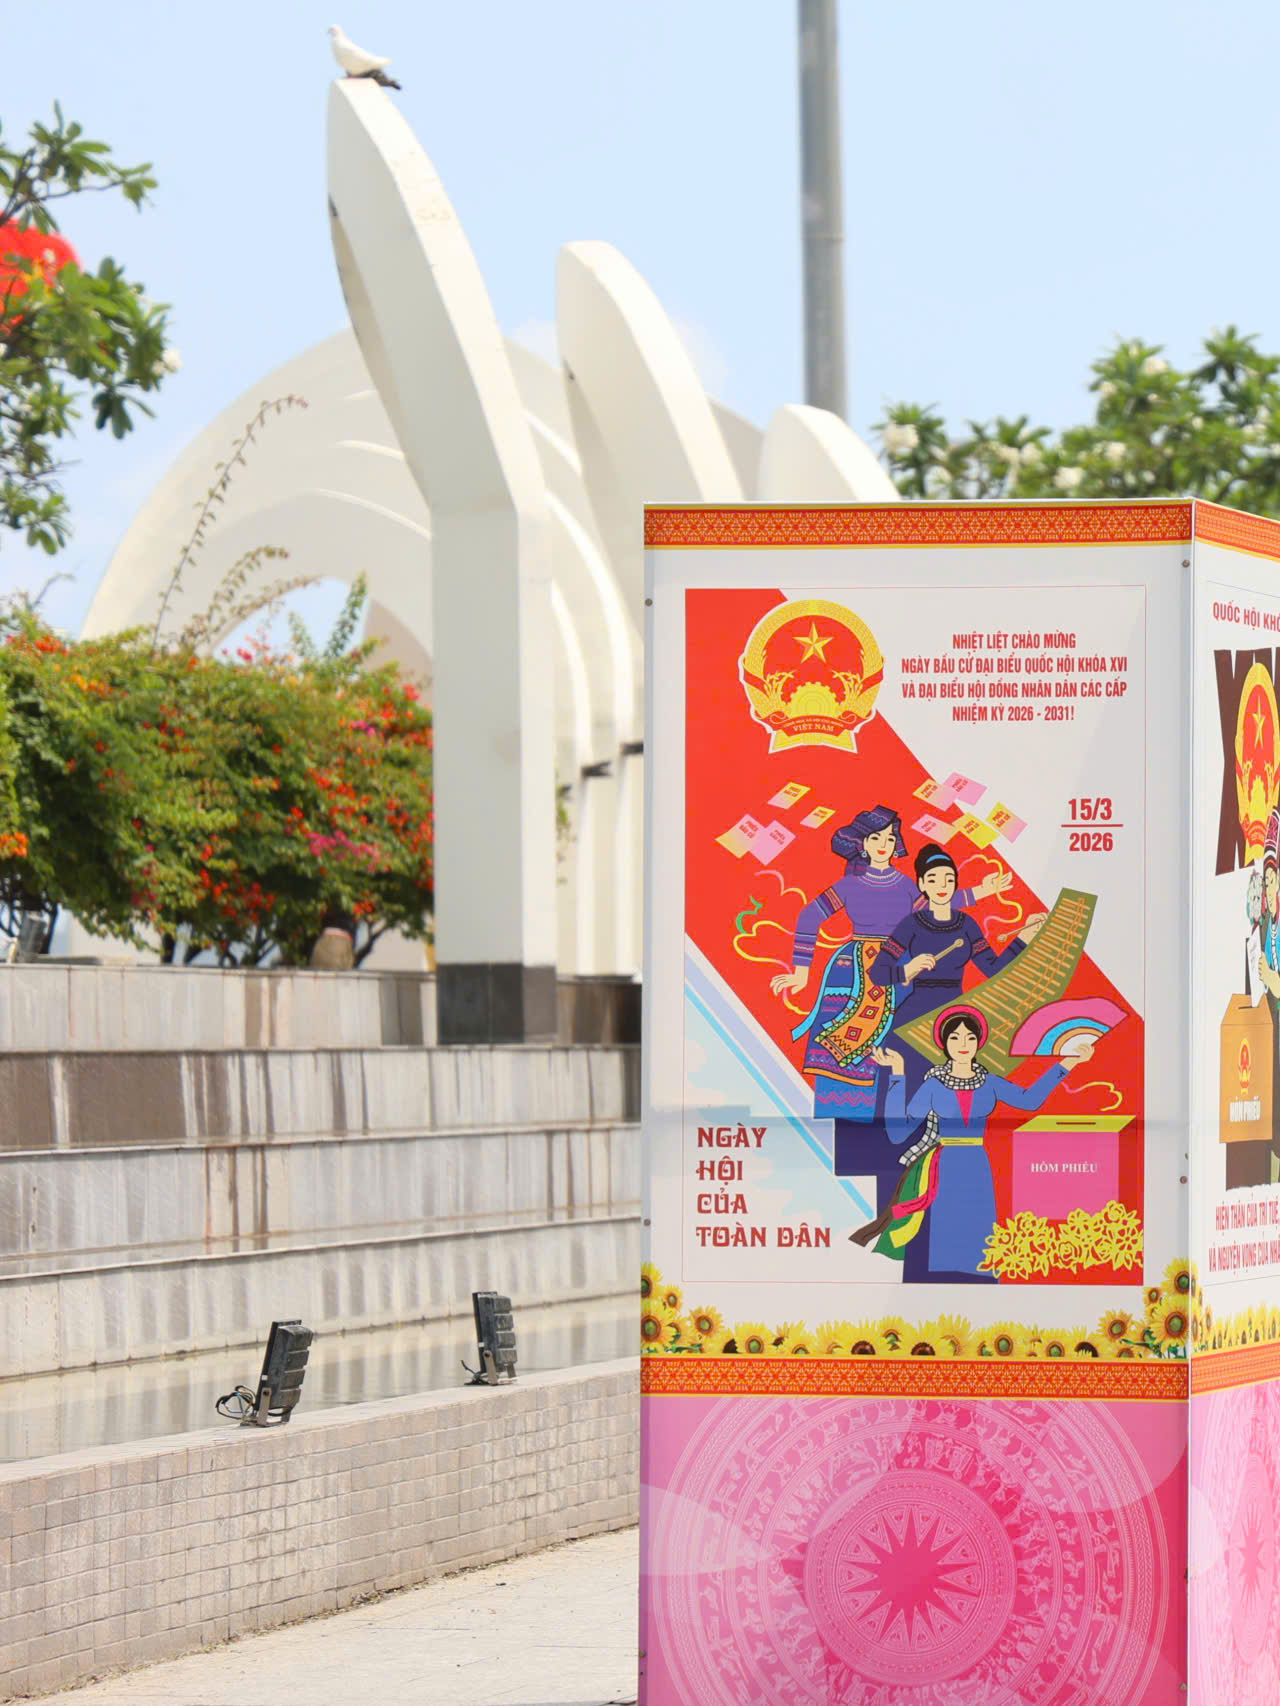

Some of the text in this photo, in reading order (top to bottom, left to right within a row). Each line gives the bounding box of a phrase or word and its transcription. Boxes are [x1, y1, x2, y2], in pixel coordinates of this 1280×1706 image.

[1213, 600, 1241, 623] QUỐC
[1243, 607, 1261, 630] HỘI
[952, 629, 1076, 653] NHIỆT LIỆT CHÀO MỪNG
[901, 651, 1128, 677] NGÀY BẦU CỬ ĐẠI BIỂU QUỐC HỘI KHÓA XVI
[901, 676, 1128, 702] VÀ ĐẠI BIỂU HỘI ĐỒNG NHÂN DÂN CÁC CẤP
[952, 703, 988, 724] NHIỆM
[991, 703, 1004, 721] KỲ
[1007, 706, 1034, 721] 2026
[1044, 705, 1075, 721] 2031!
[1068, 797, 1113, 821] 15/3
[1069, 832, 1113, 852] 2026
[697, 1122, 768, 1148] NGÀY
[695, 1155, 743, 1186] HỘI
[1031, 1160, 1097, 1173] HÒM PHIẾU
[697, 1187, 748, 1214] CỦA
[695, 1221, 831, 1247] TOÀN DÂN
